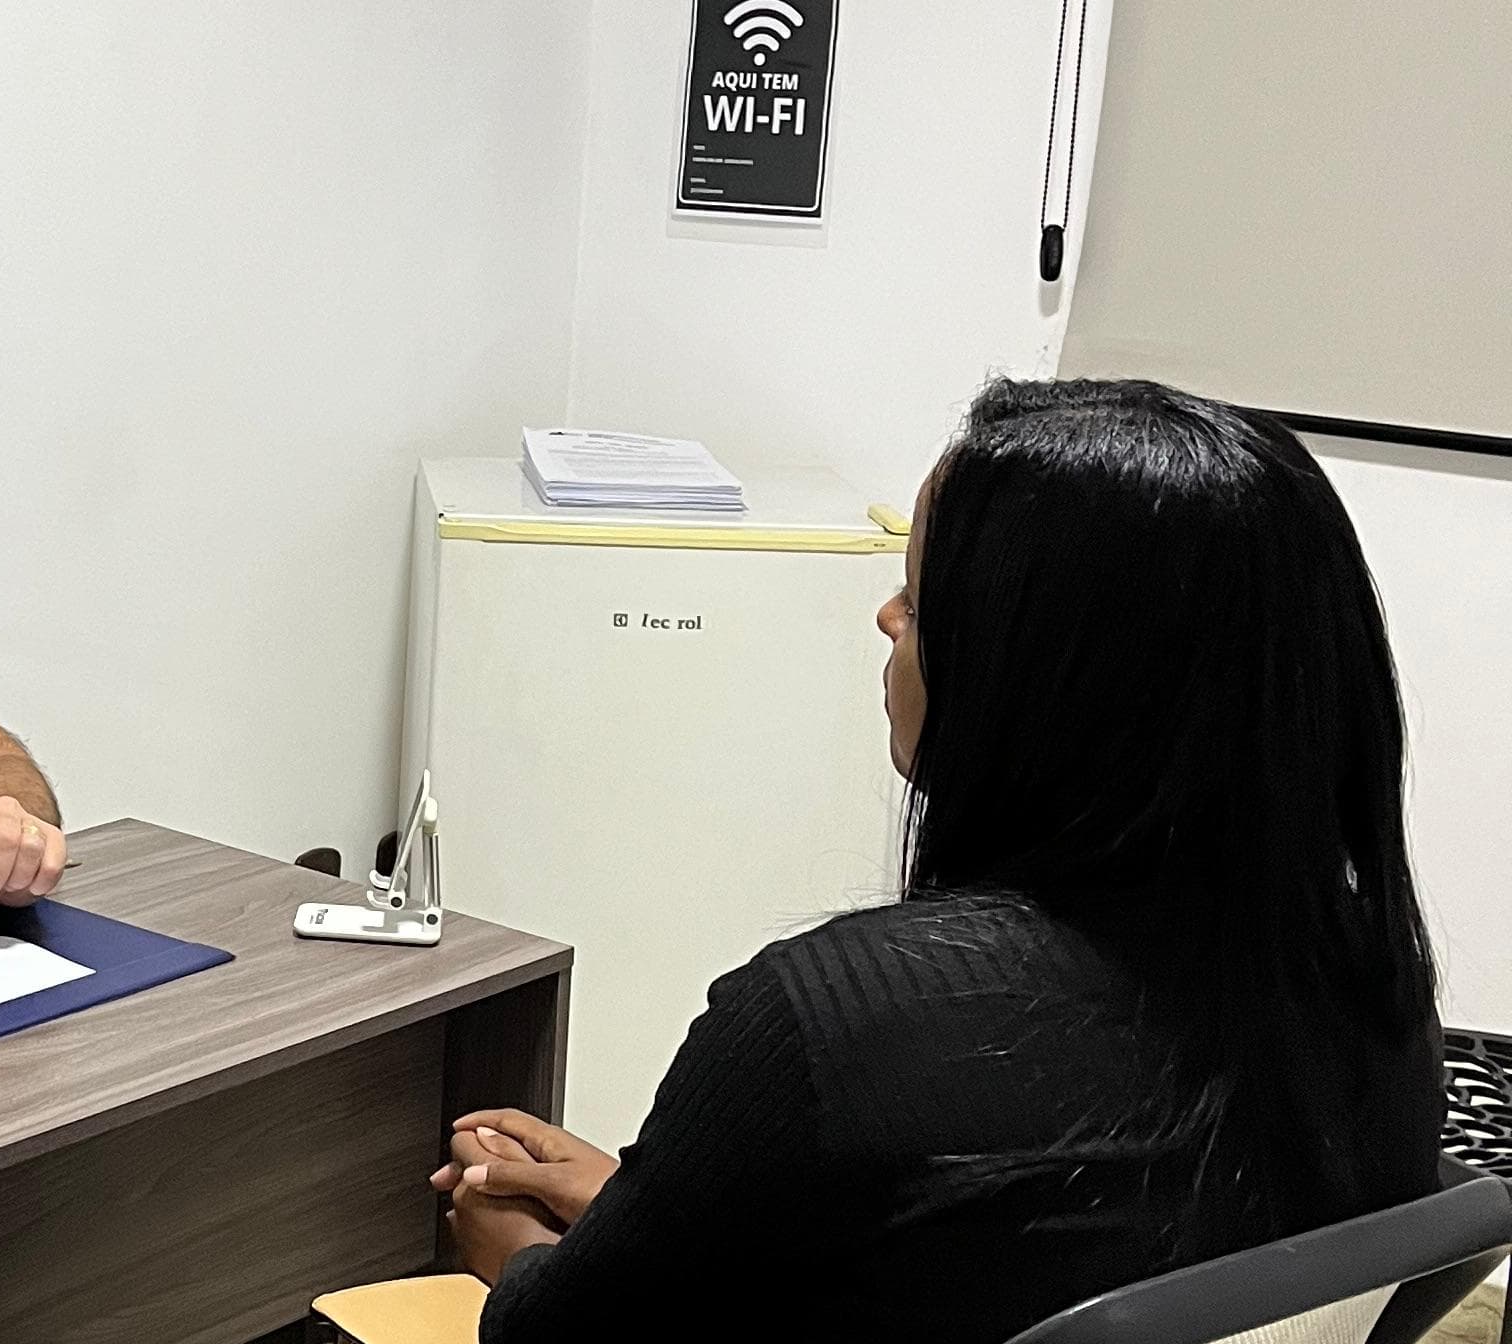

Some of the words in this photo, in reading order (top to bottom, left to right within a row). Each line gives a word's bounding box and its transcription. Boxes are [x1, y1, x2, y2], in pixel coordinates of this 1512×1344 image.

[712, 72, 757, 91] AQUI
[762, 74, 798, 90] TEM
[704, 95, 805, 135] WI-FI
